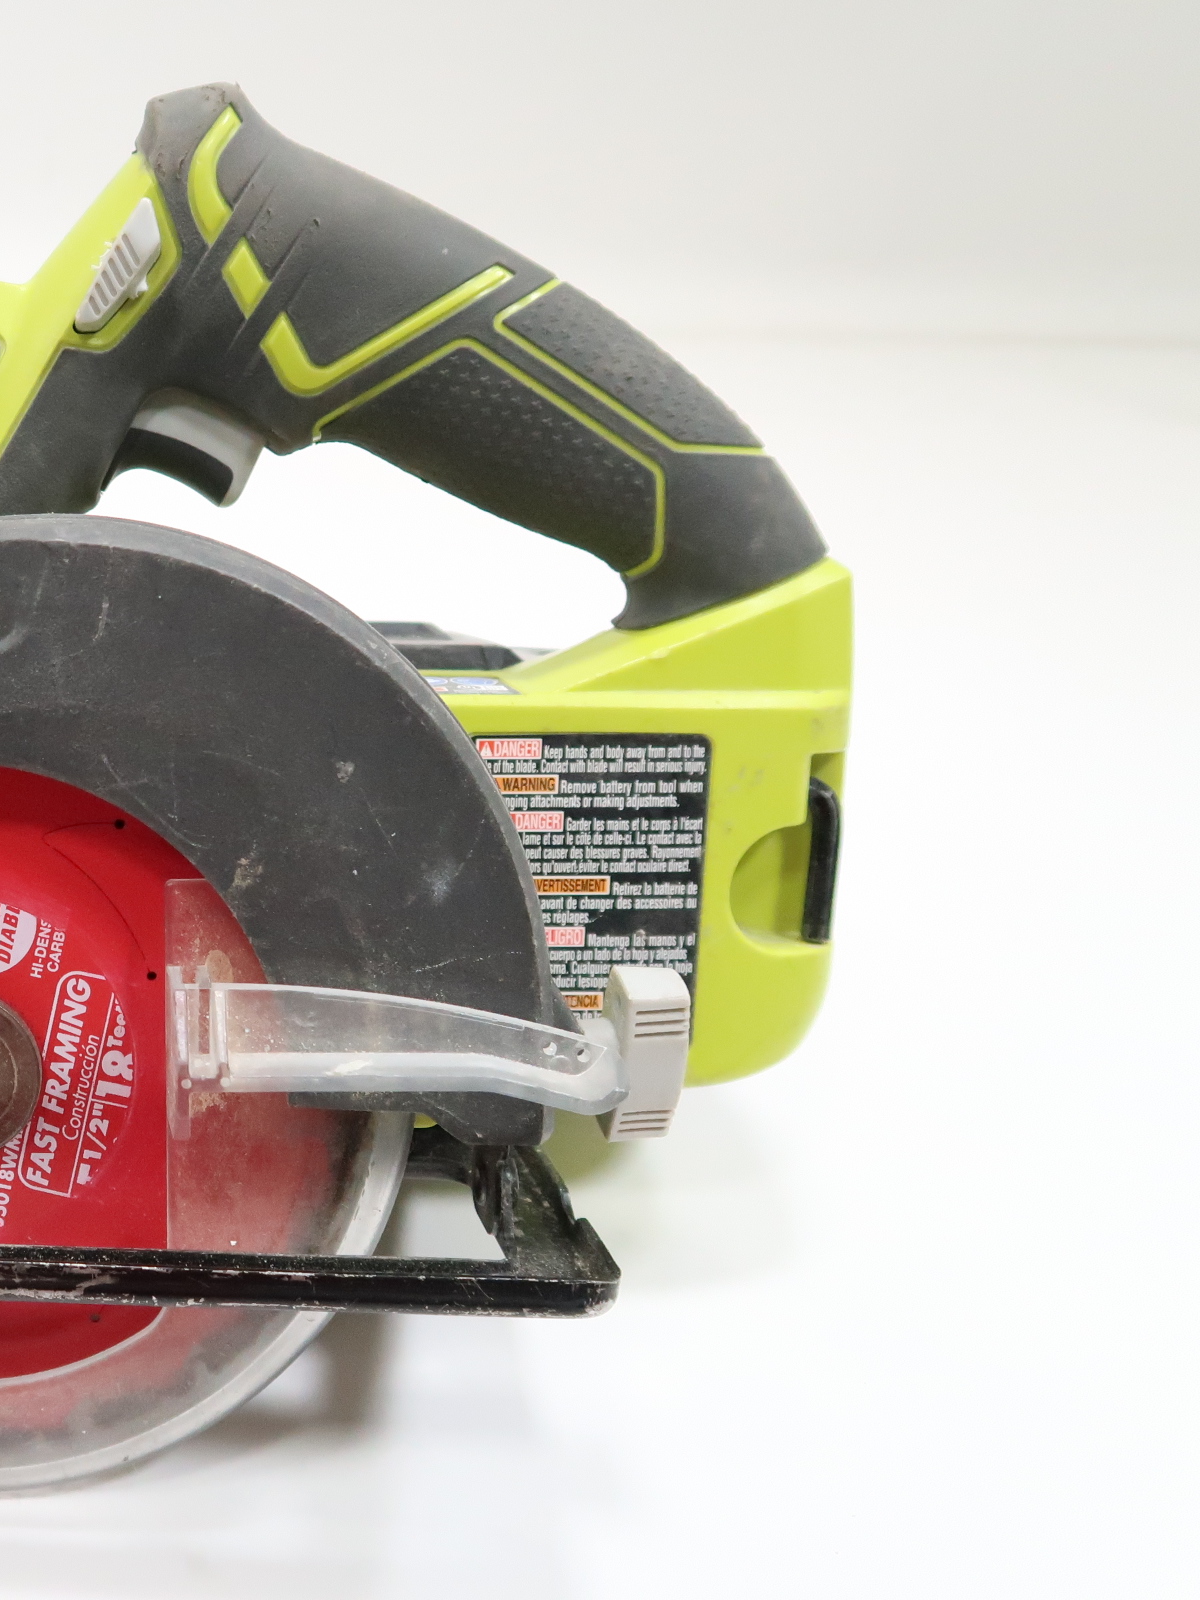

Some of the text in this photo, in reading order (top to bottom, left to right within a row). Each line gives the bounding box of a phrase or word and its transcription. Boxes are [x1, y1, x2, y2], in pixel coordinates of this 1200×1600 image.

[494, 741, 706, 761] DANGER Keep hands and body away from and to the
[494, 760, 501, 772] of
[502, 760, 514, 772] the
[516, 760, 538, 772] blade.
[541, 760, 568, 772] Contact
[570, 760, 586, 772] with
[586, 760, 608, 772] blade
[609, 760, 623, 772] will
[624, 760, 646, 772] result
[647, 760, 654, 772] in
[656, 760, 682, 772] serious
[502, 778, 704, 796] WARNING Remove battery from tool when
[530, 795, 581, 808] attachments
[582, 797, 592, 808] or
[593, 794, 624, 810] making
[626, 794, 680, 810] adjustments.
[516, 814, 560, 829] DANGER
[566, 816, 592, 831] Garder
[594, 818, 604, 830] les
[606, 818, 630, 830] mains
[632, 818, 640, 830] et
[641, 818, 649, 830] le
[650, 819, 671, 833] corps
[522, 832, 541, 845] lame
[543, 832, 551, 845] et
[552, 834, 564, 845] sur
[566, 832, 574, 845] le
[593, 832, 602, 845] de
[636, 832, 646, 845] Le
[647, 832, 675, 845] contact
[676, 834, 694, 845] avec
[694, 832, 702, 845] la
[544, 848, 568, 859] causer
[570, 846, 584, 859] des
[586, 846, 620, 859] blessures
[622, 848, 650, 861] graves.
[651, 846, 702, 861] Rayonnement
[601, 860, 608, 872] le
[610, 860, 636, 872] contact
[612, 882, 642, 895] Retirez
[644, 882, 652, 895] la
[654, 882, 686, 895] batterie
[686, 882, 698, 895] de
[541, 896, 697, 912] avant de changer des accessoires ou
[588, 934, 630, 949] Mantenga
[634, 934, 646, 946] las
[648, 936, 676, 946] manos
[686, 932, 696, 946] el
[583, 951, 593, 960] un
[594, 948, 611, 960] lado
[612, 948, 622, 960] de
[624, 948, 631, 960] la
[632, 948, 648, 963] hoja
[42, 978, 91, 1115] FRAMING
[62, 1034, 100, 1140] Construcción
[26, 1116, 60, 1186] FAST
